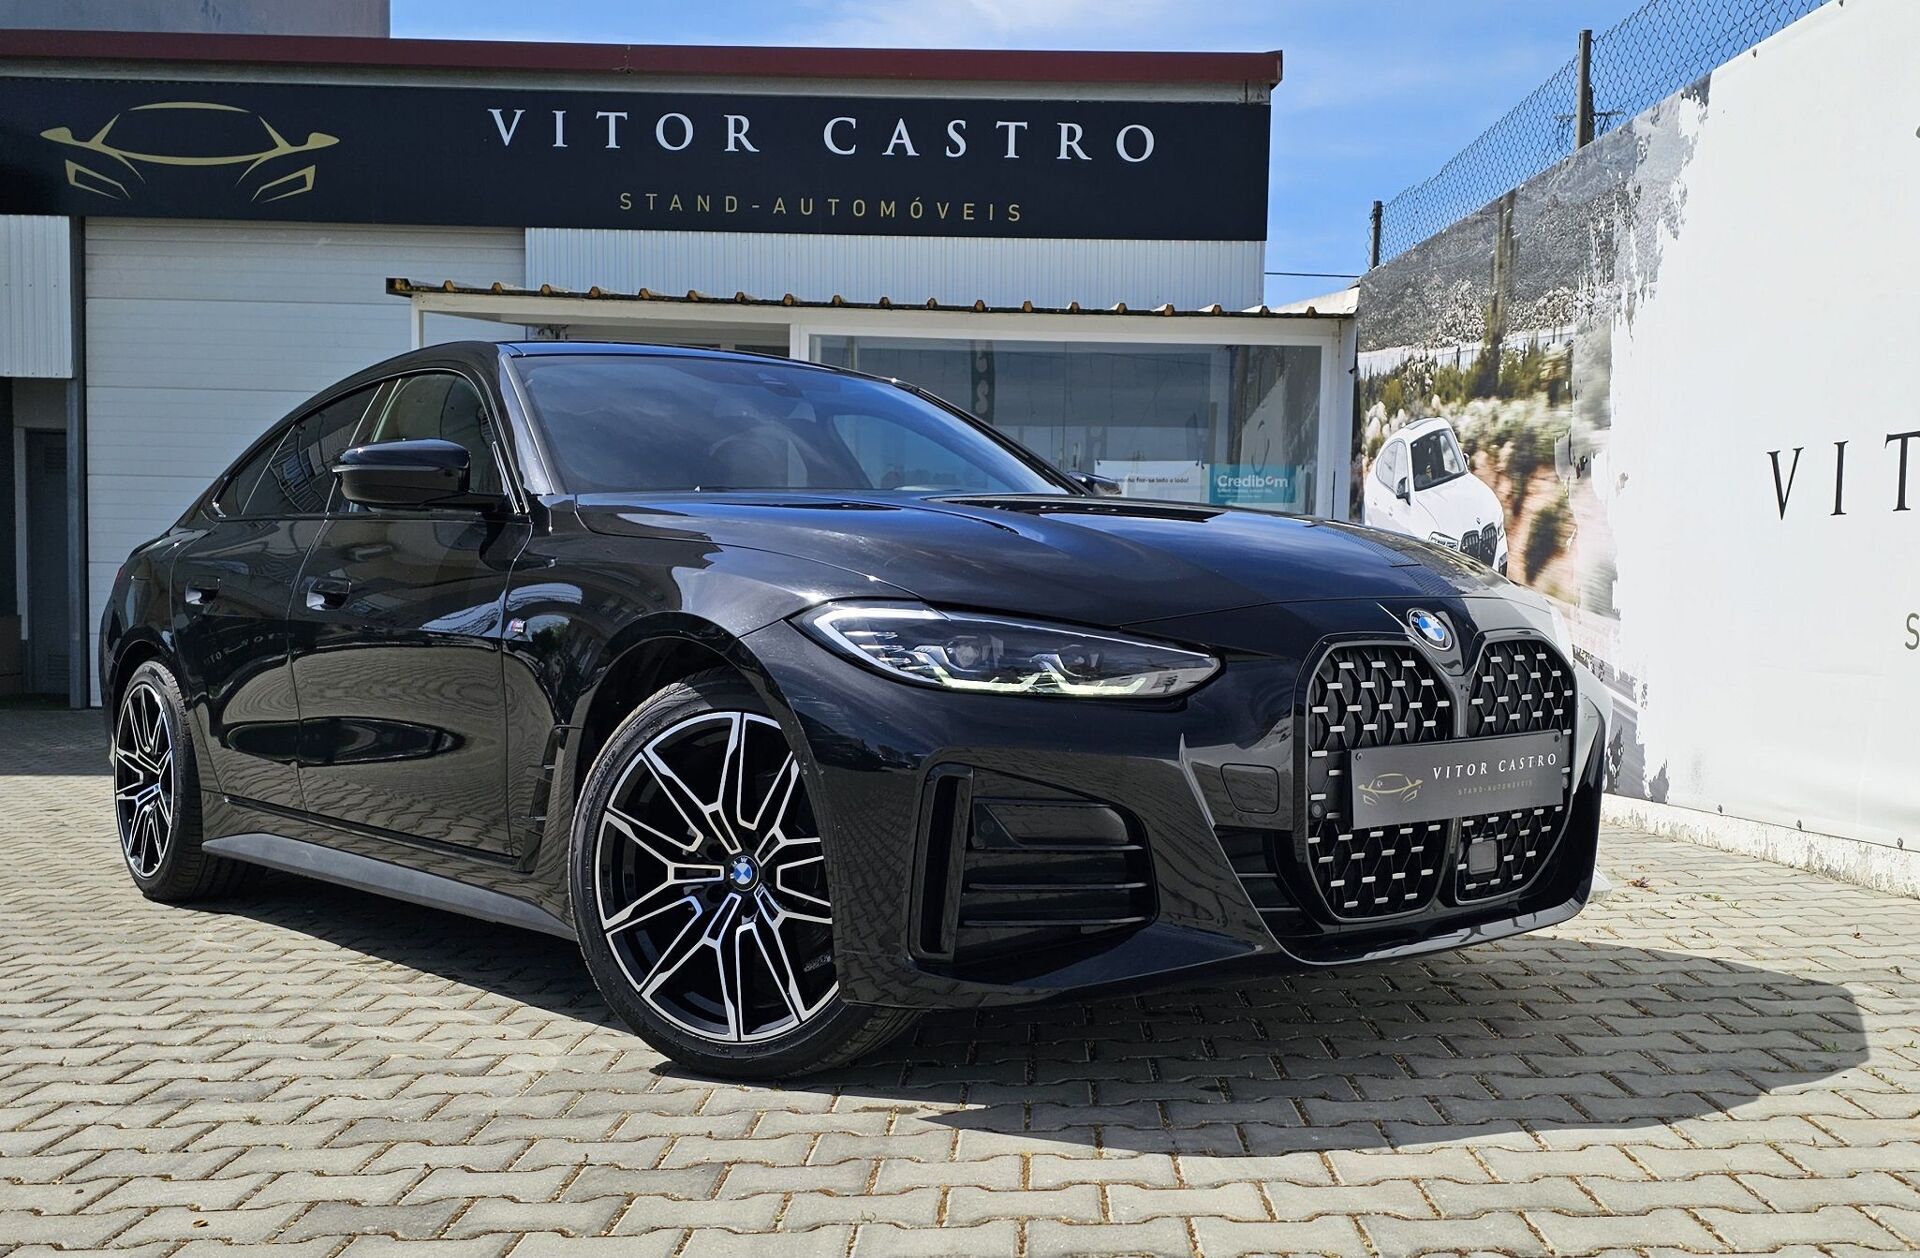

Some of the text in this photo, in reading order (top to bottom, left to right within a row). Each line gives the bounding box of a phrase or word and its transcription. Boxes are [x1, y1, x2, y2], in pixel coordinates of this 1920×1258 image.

[487, 108, 1156, 163] VITOR CASTRO
[619, 192, 1022, 222] STAND-AUTOMÓVEIS
[1217, 474, 1288, 488] Credibom
[1433, 753, 1557, 780] VITOR CASTRO
